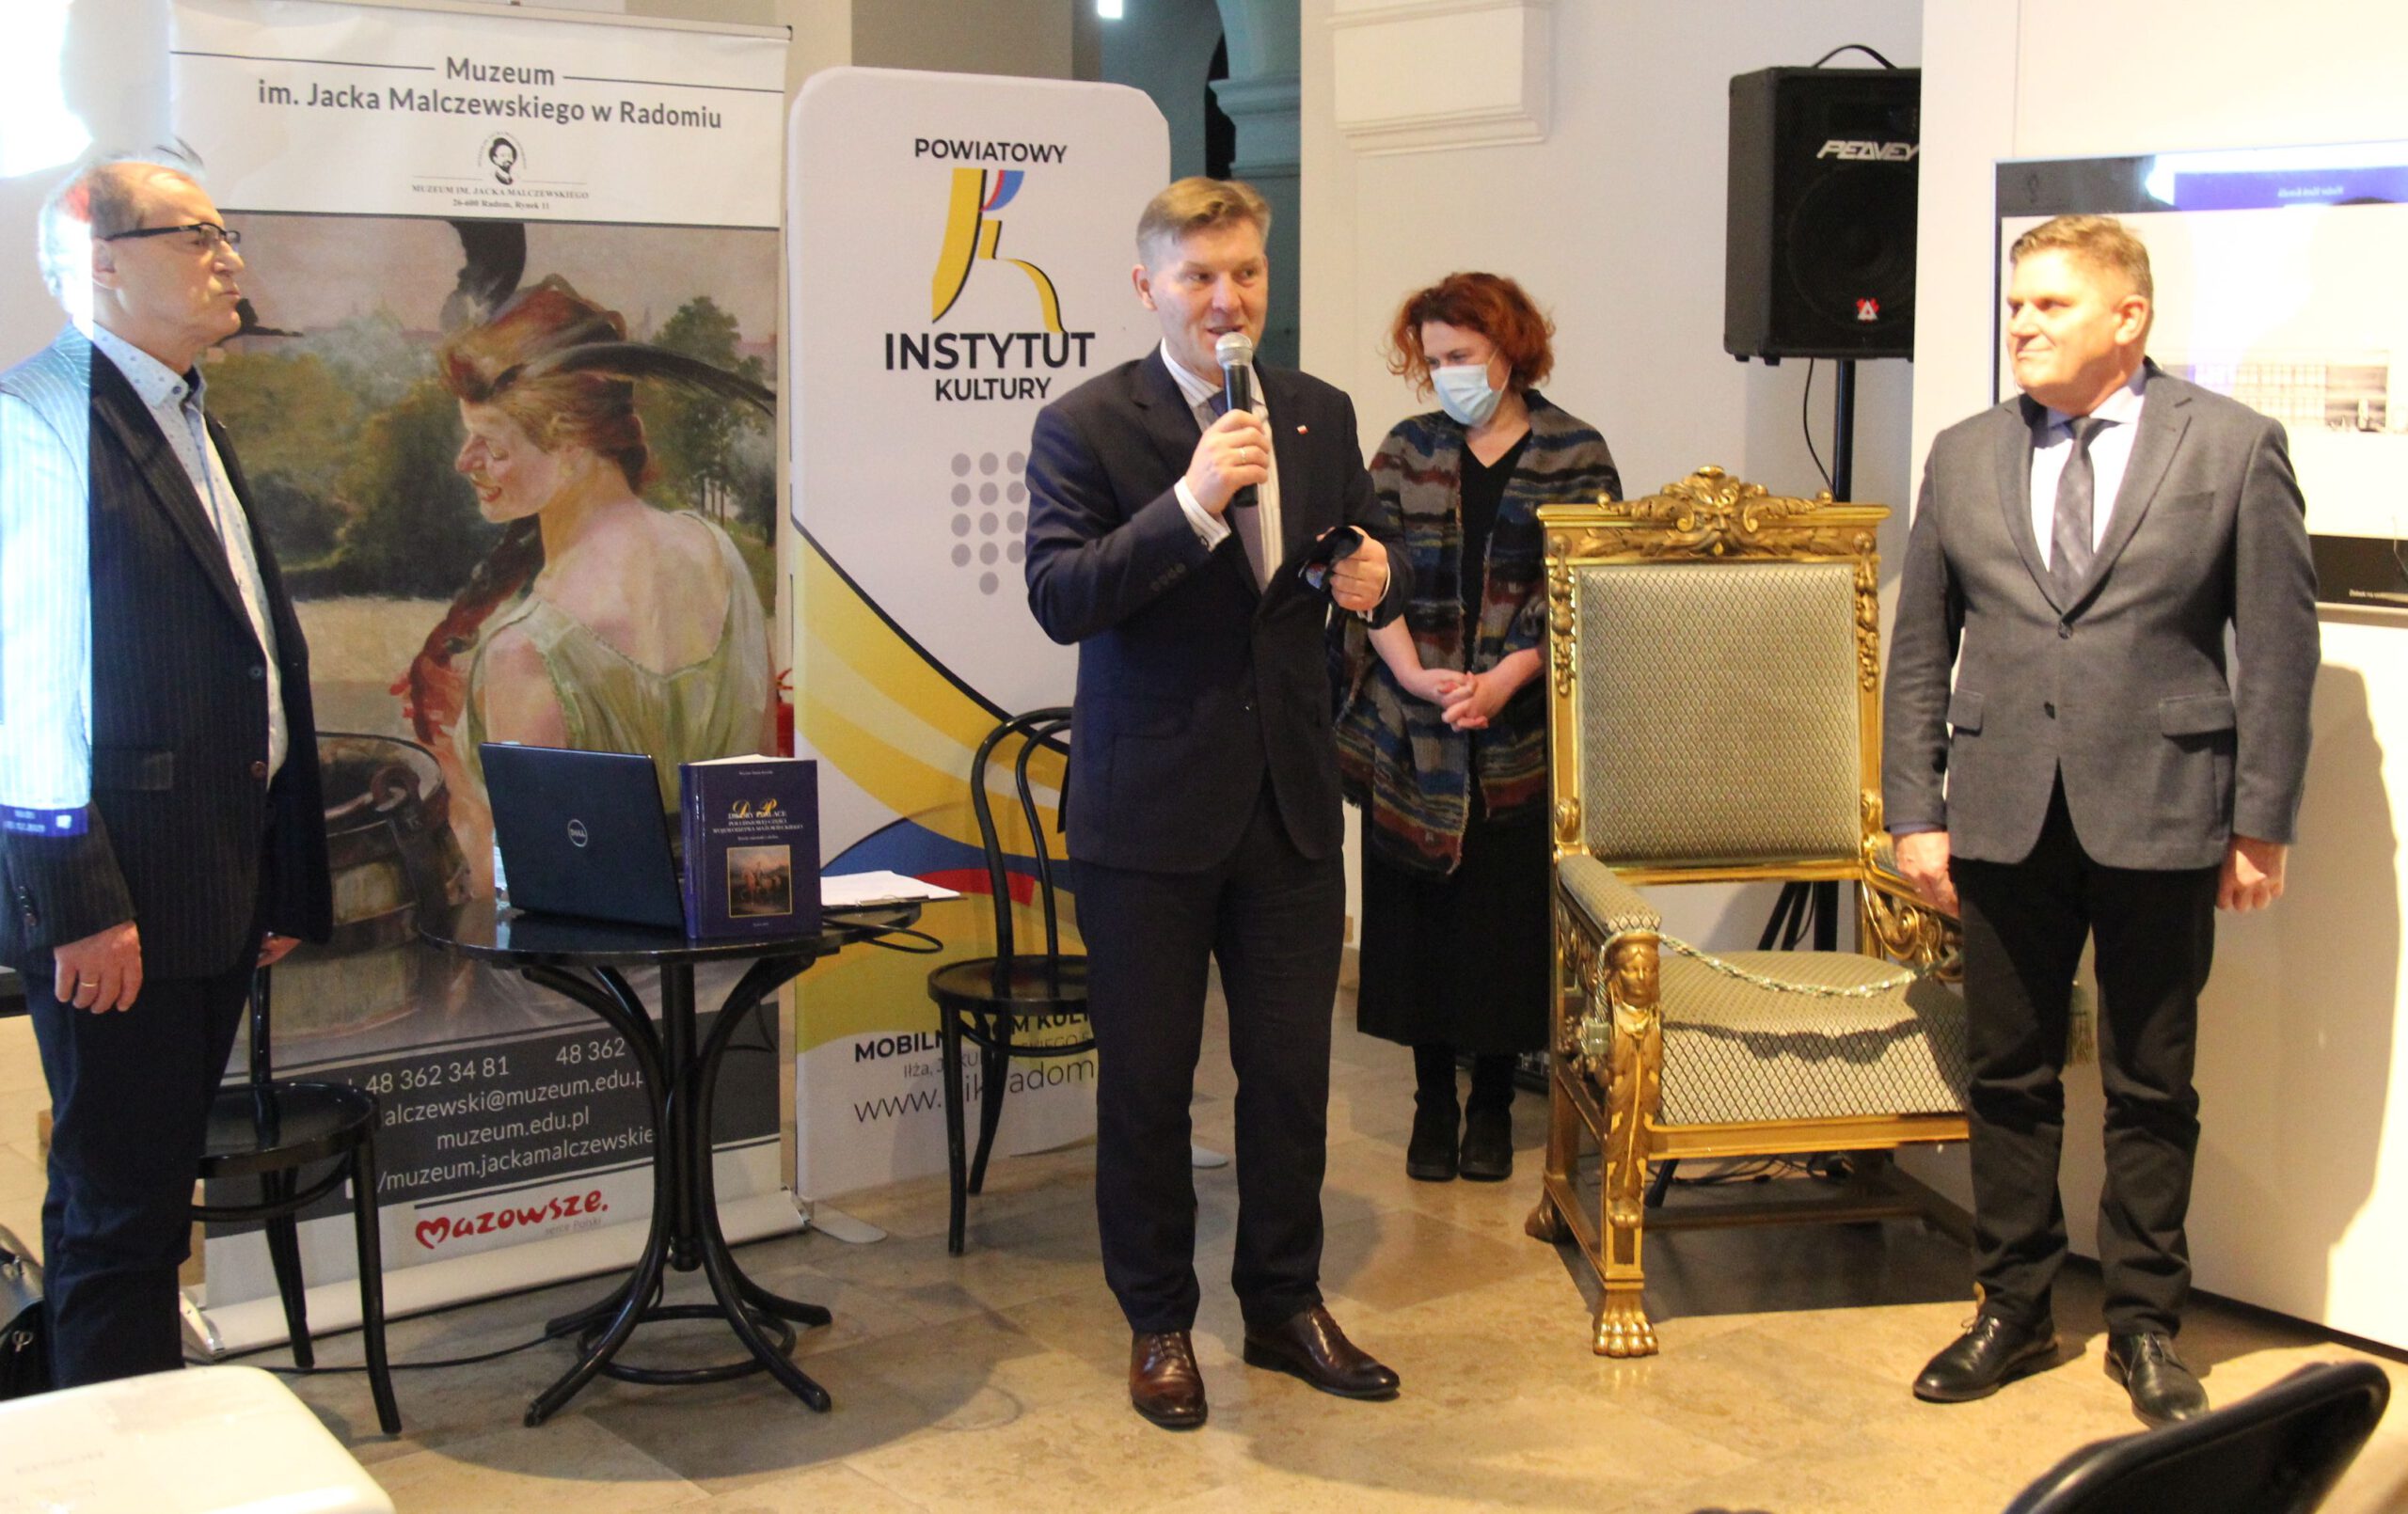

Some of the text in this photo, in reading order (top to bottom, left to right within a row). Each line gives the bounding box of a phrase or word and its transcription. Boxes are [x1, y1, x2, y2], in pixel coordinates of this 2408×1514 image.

[446, 55, 557, 87] Muzeum
[258, 78, 723, 130] im. Jacka Malczewskiego w Radomiu
[914, 138, 1068, 164] POWIATOWY
[1816, 140, 1920, 161] PEAVEY
[411, 183, 455, 196] MUZEUM
[472, 187, 507, 197] JACKA
[507, 188, 590, 201] MALCZEWSKIEGO
[884, 332, 1096, 371] INSTYTUT
[935, 377, 1053, 402] KULTURY
[365, 1037, 626, 1095] 48 362 34 81 48 362
[385, 1069, 644, 1126] alczewski@muzeum.edu.p
[436, 1105, 590, 1150] muzeum.edu.pl
[377, 1127, 654, 1192] /muzeum.jackamalczewskie
